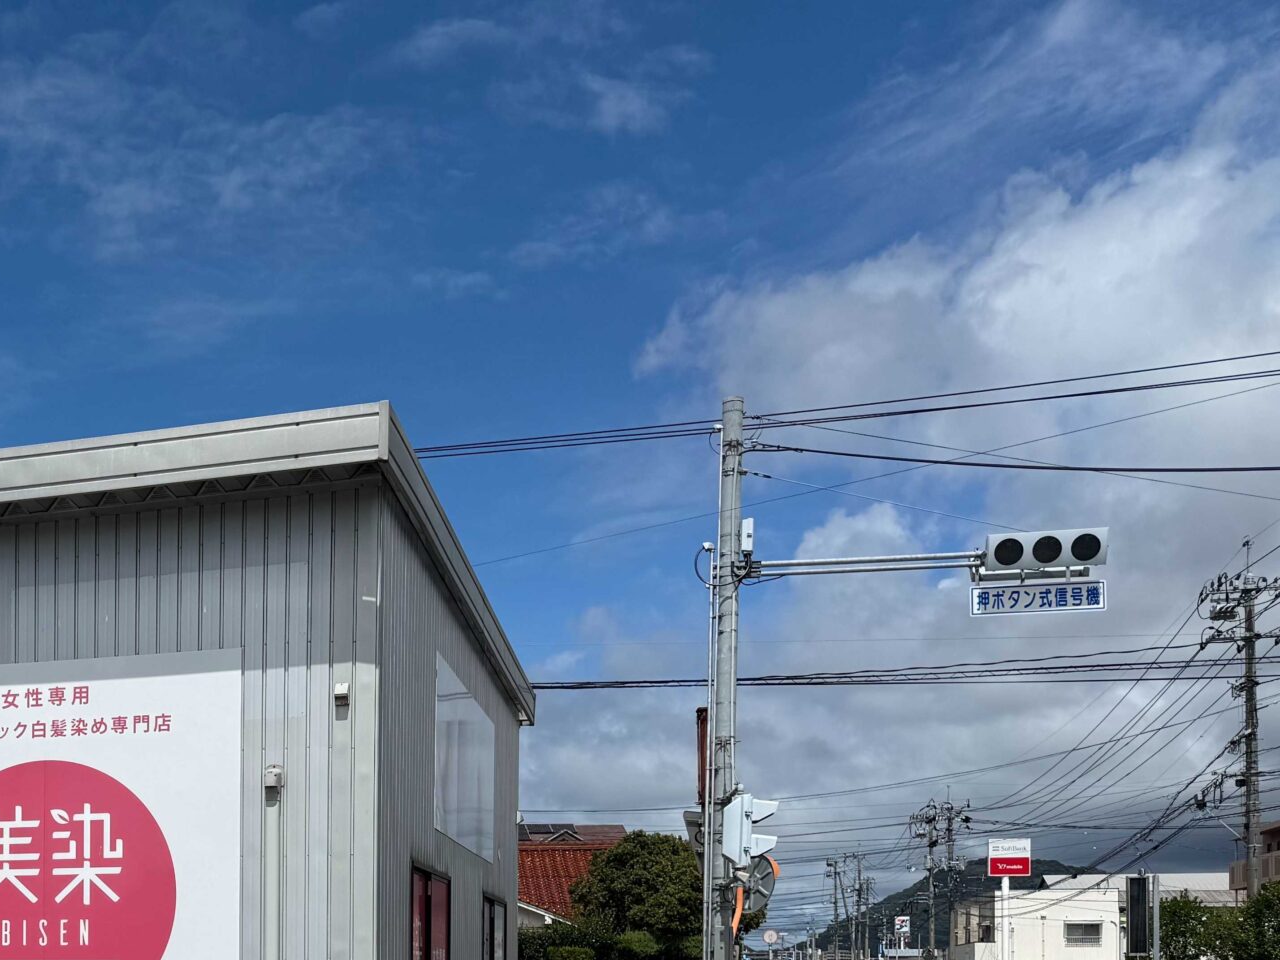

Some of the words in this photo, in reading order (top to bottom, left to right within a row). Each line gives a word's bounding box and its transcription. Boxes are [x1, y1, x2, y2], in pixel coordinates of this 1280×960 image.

[976, 585, 1102, 611] 押ボタン式信号機
[1, 685, 90, 709] 女性専用
[1, 919, 89, 947] BISEN
